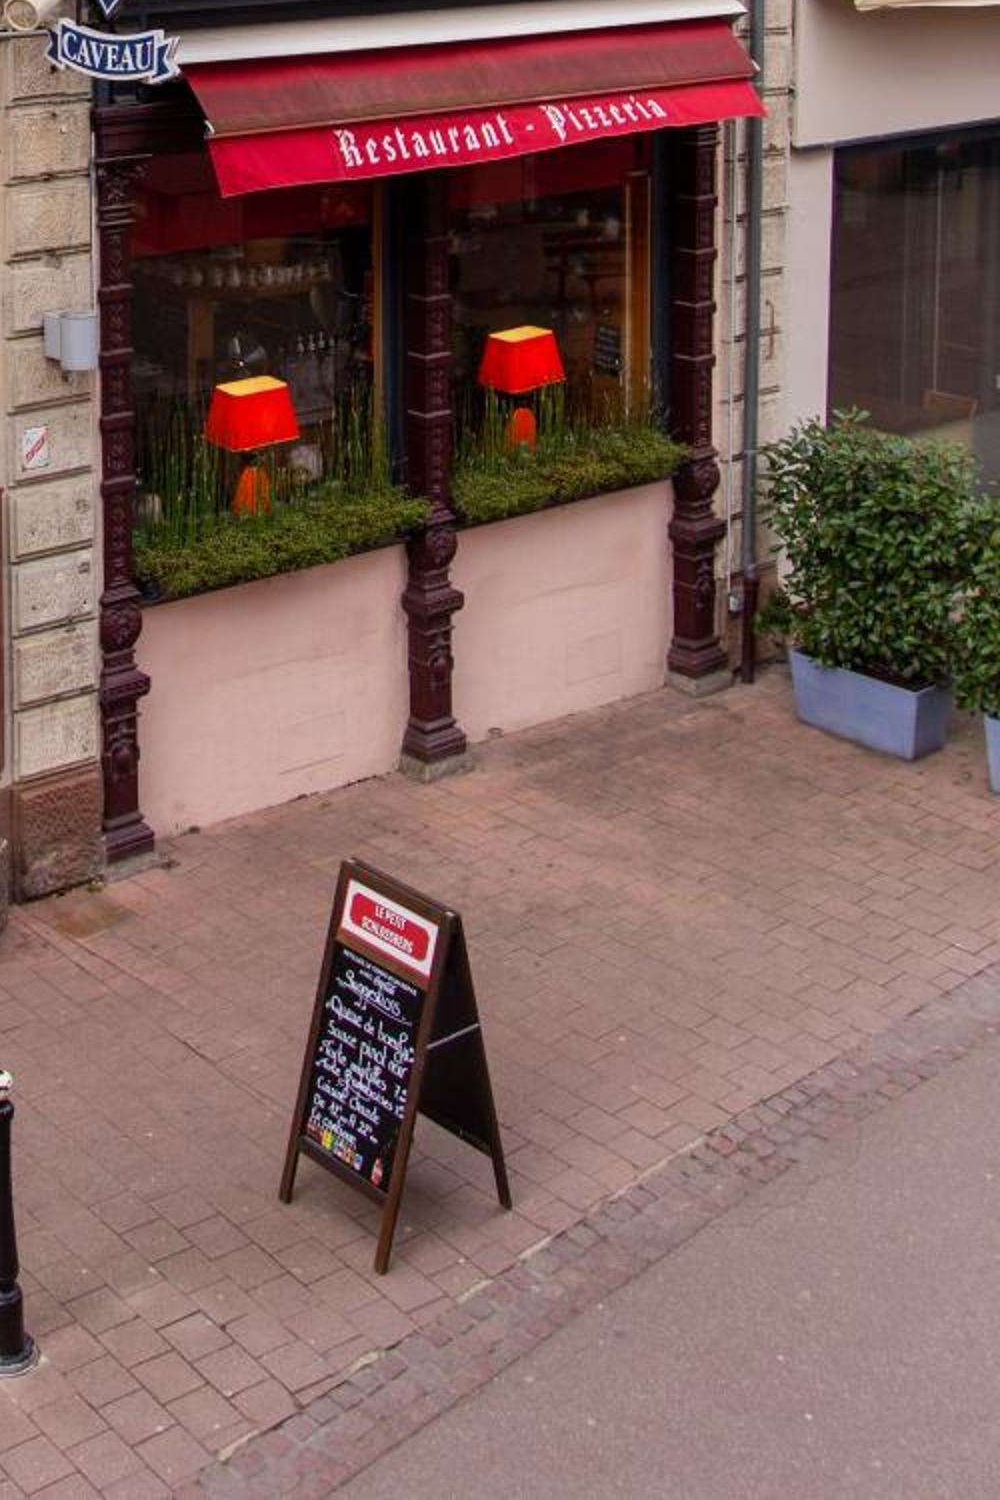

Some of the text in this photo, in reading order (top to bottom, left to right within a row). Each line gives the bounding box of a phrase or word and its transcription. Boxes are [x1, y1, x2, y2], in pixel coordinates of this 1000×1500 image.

[63, 31, 152, 73] CAVEAU
[334, 114, 514, 167] Restaurant
[540, 95, 667, 142] Pizzeria
